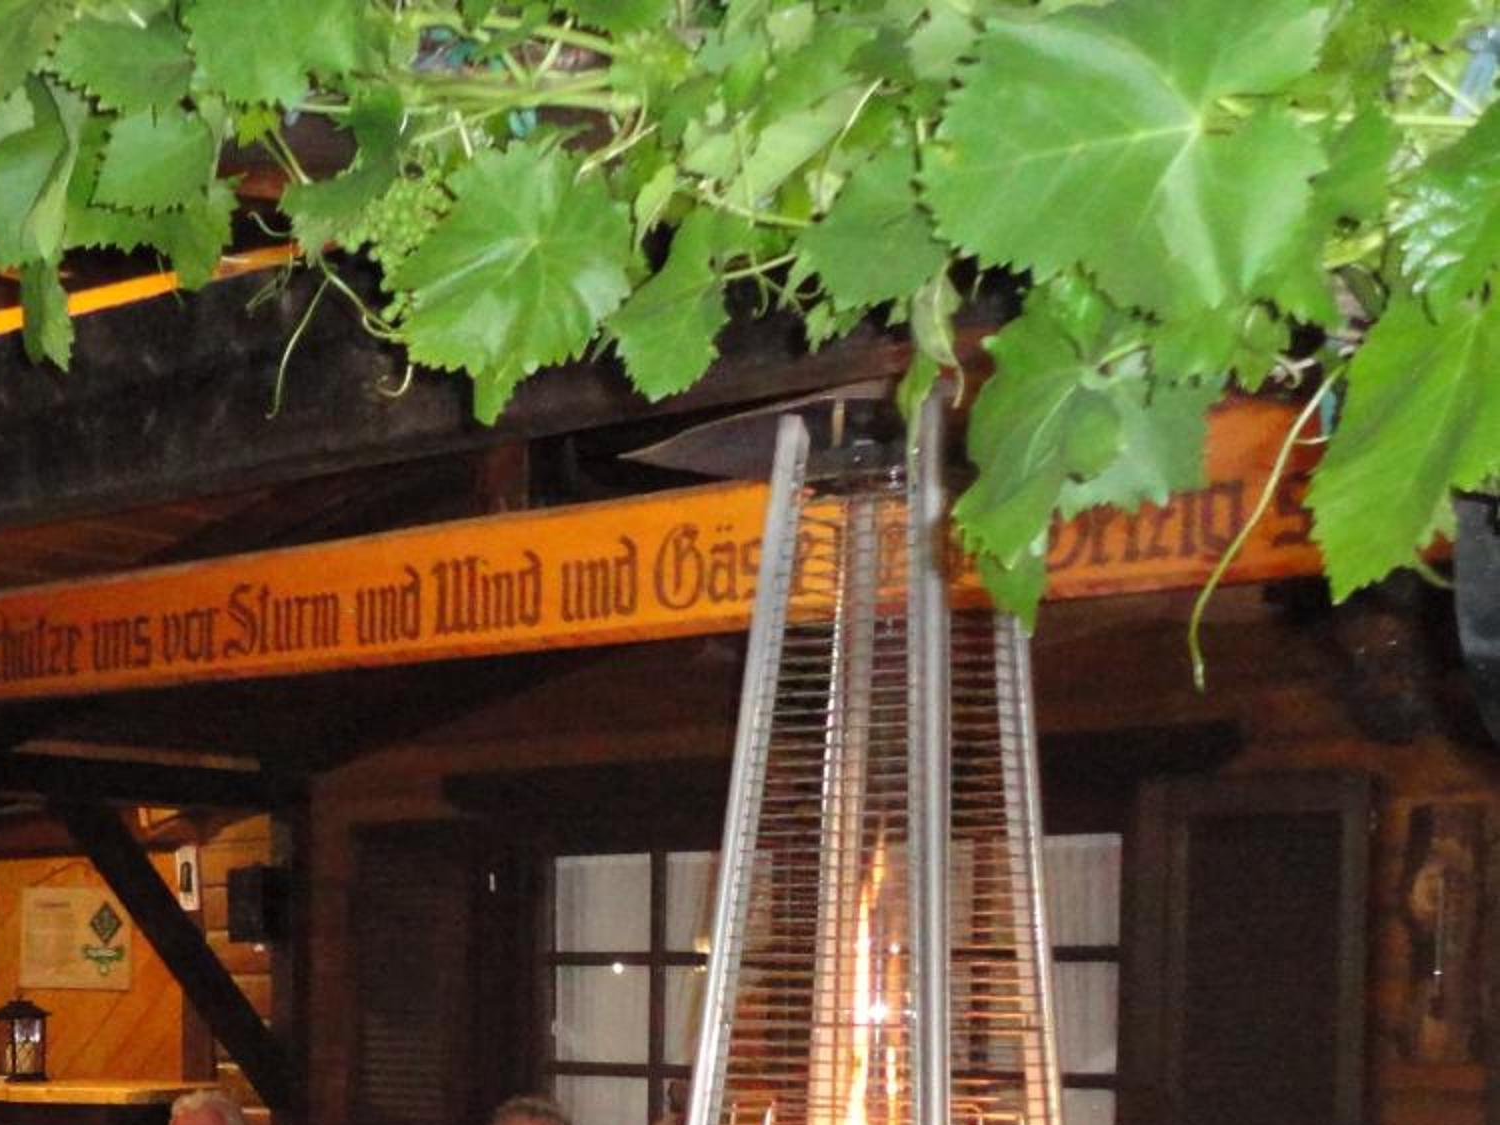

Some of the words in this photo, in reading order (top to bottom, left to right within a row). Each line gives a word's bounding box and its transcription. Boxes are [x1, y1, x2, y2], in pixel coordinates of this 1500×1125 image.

[93, 615, 151, 673] uns
[161, 606, 219, 665] vor
[222, 583, 341, 660] Sturm
[355, 564, 422, 647] und
[432, 550, 543, 636] Wind
[560, 534, 639, 623] und
